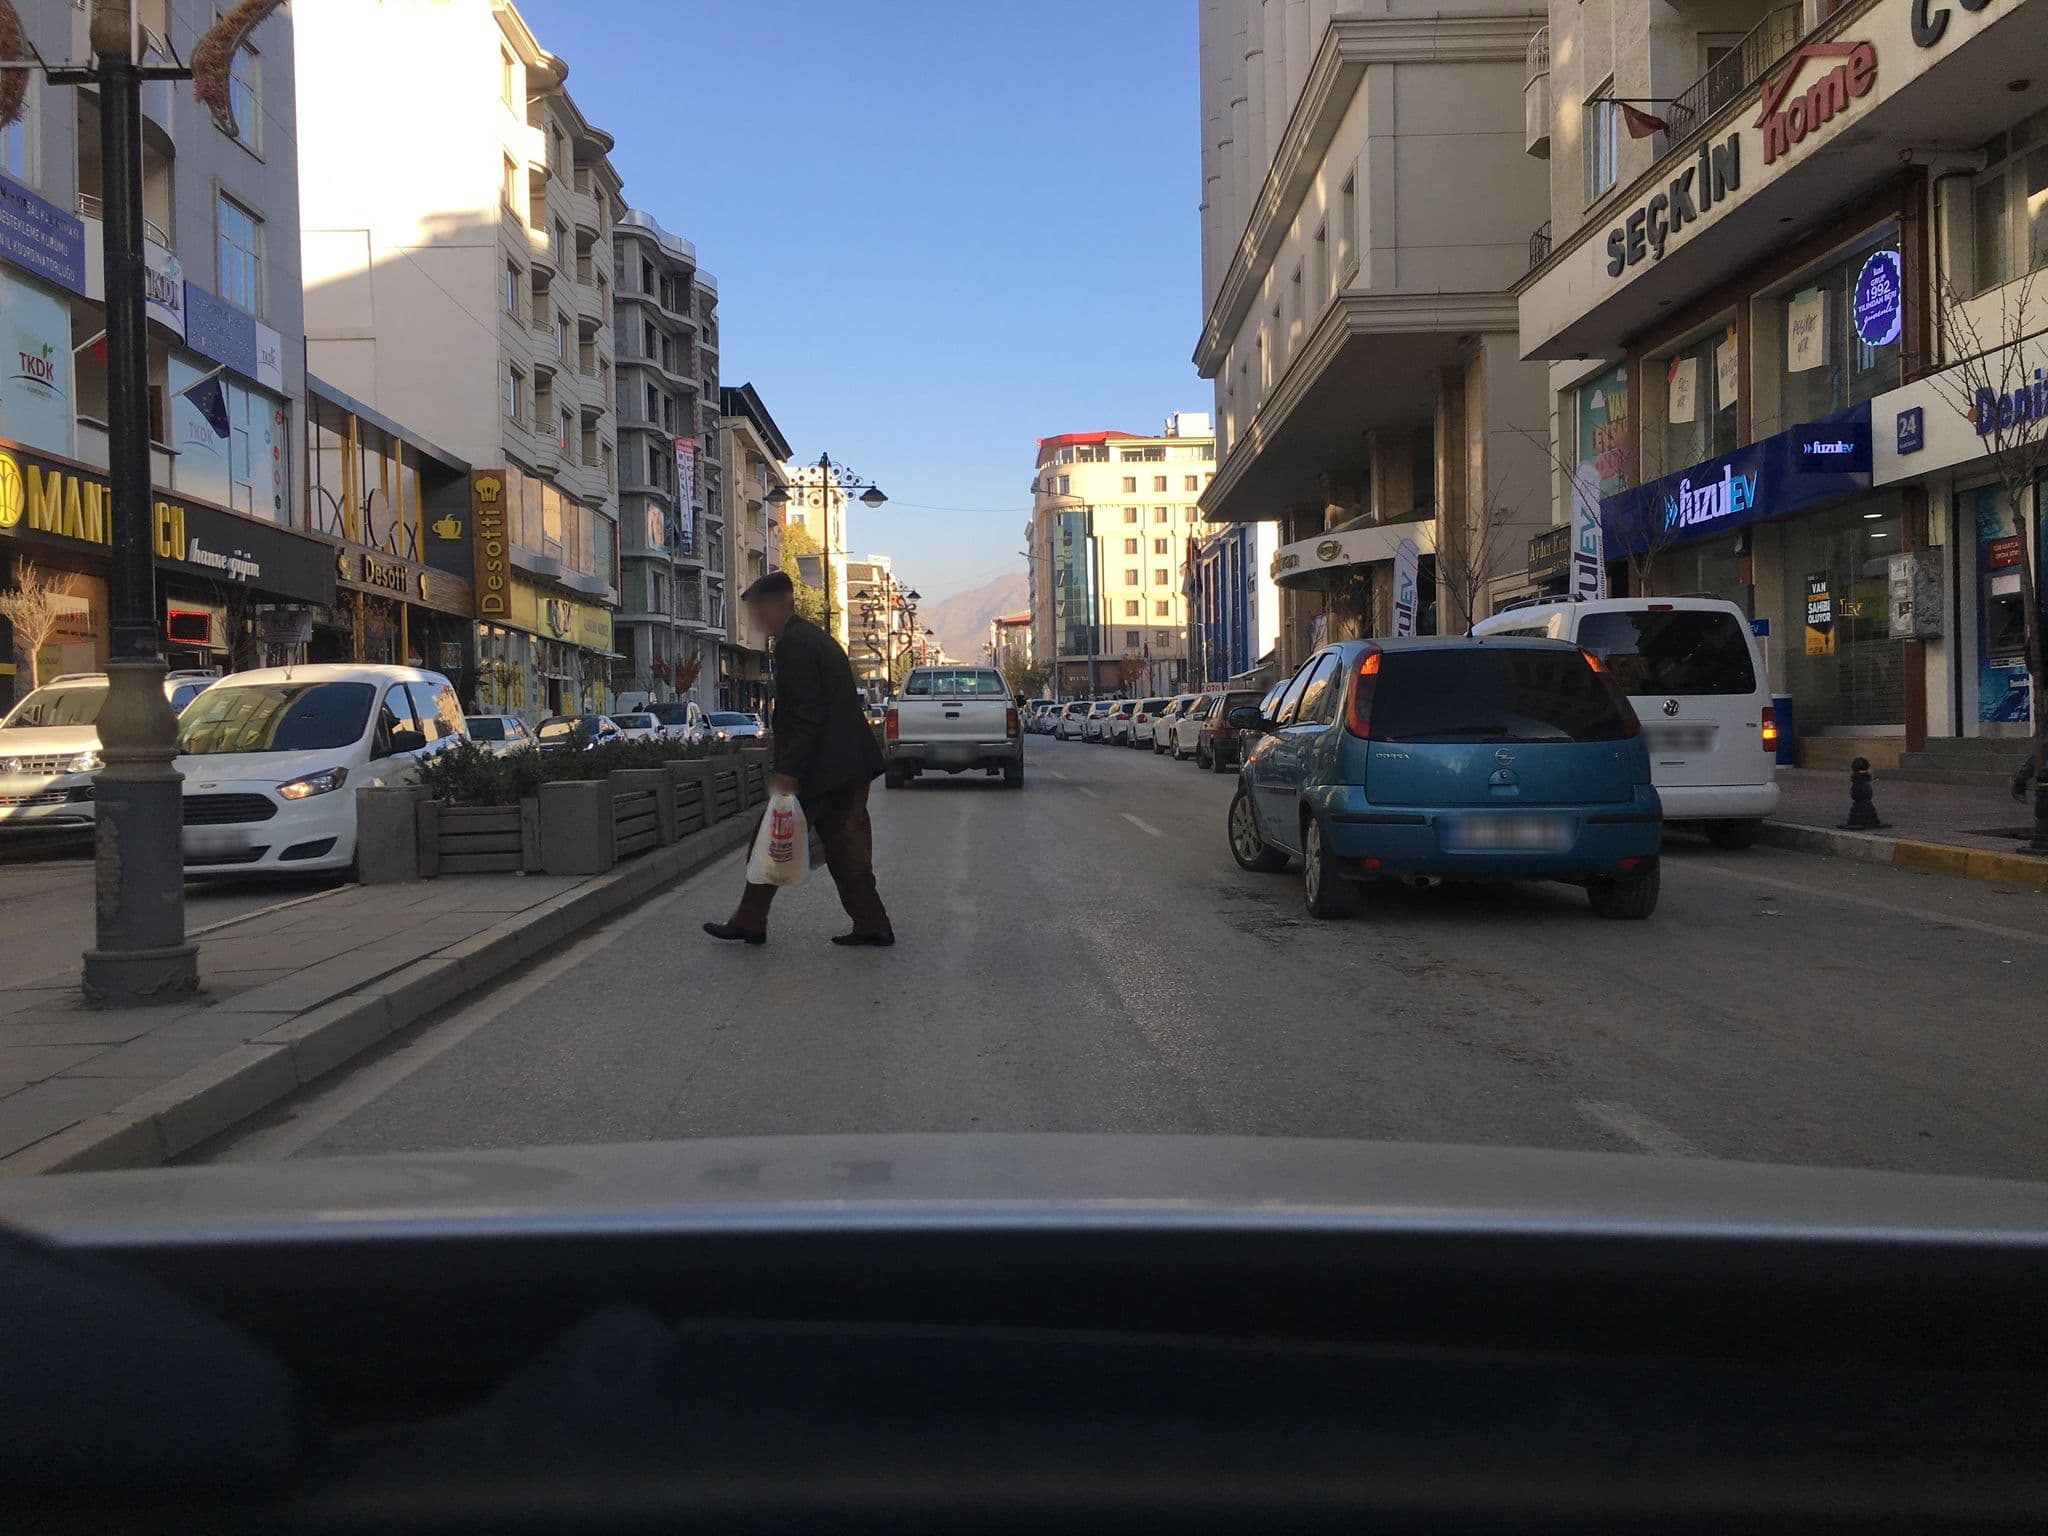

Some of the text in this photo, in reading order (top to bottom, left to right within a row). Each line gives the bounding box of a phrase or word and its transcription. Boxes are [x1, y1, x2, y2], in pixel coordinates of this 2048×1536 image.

[1607, 132, 1740, 277] SEÇKİN
[1754, 40, 1878, 165] home
[1866, 280, 1890, 302] 1992
[19, 352, 54, 381] TKDK
[189, 421, 214, 445] TKDK
[1899, 413, 1917, 438] 24
[1812, 440, 1855, 454] fuzulEV
[1679, 463, 1758, 528] fuzulEV
[362, 554, 408, 593] Desotti
[478, 509, 504, 613] Desotti
[1811, 582, 1827, 594] VAN
[1807, 613, 1832, 624] OLUYOR
